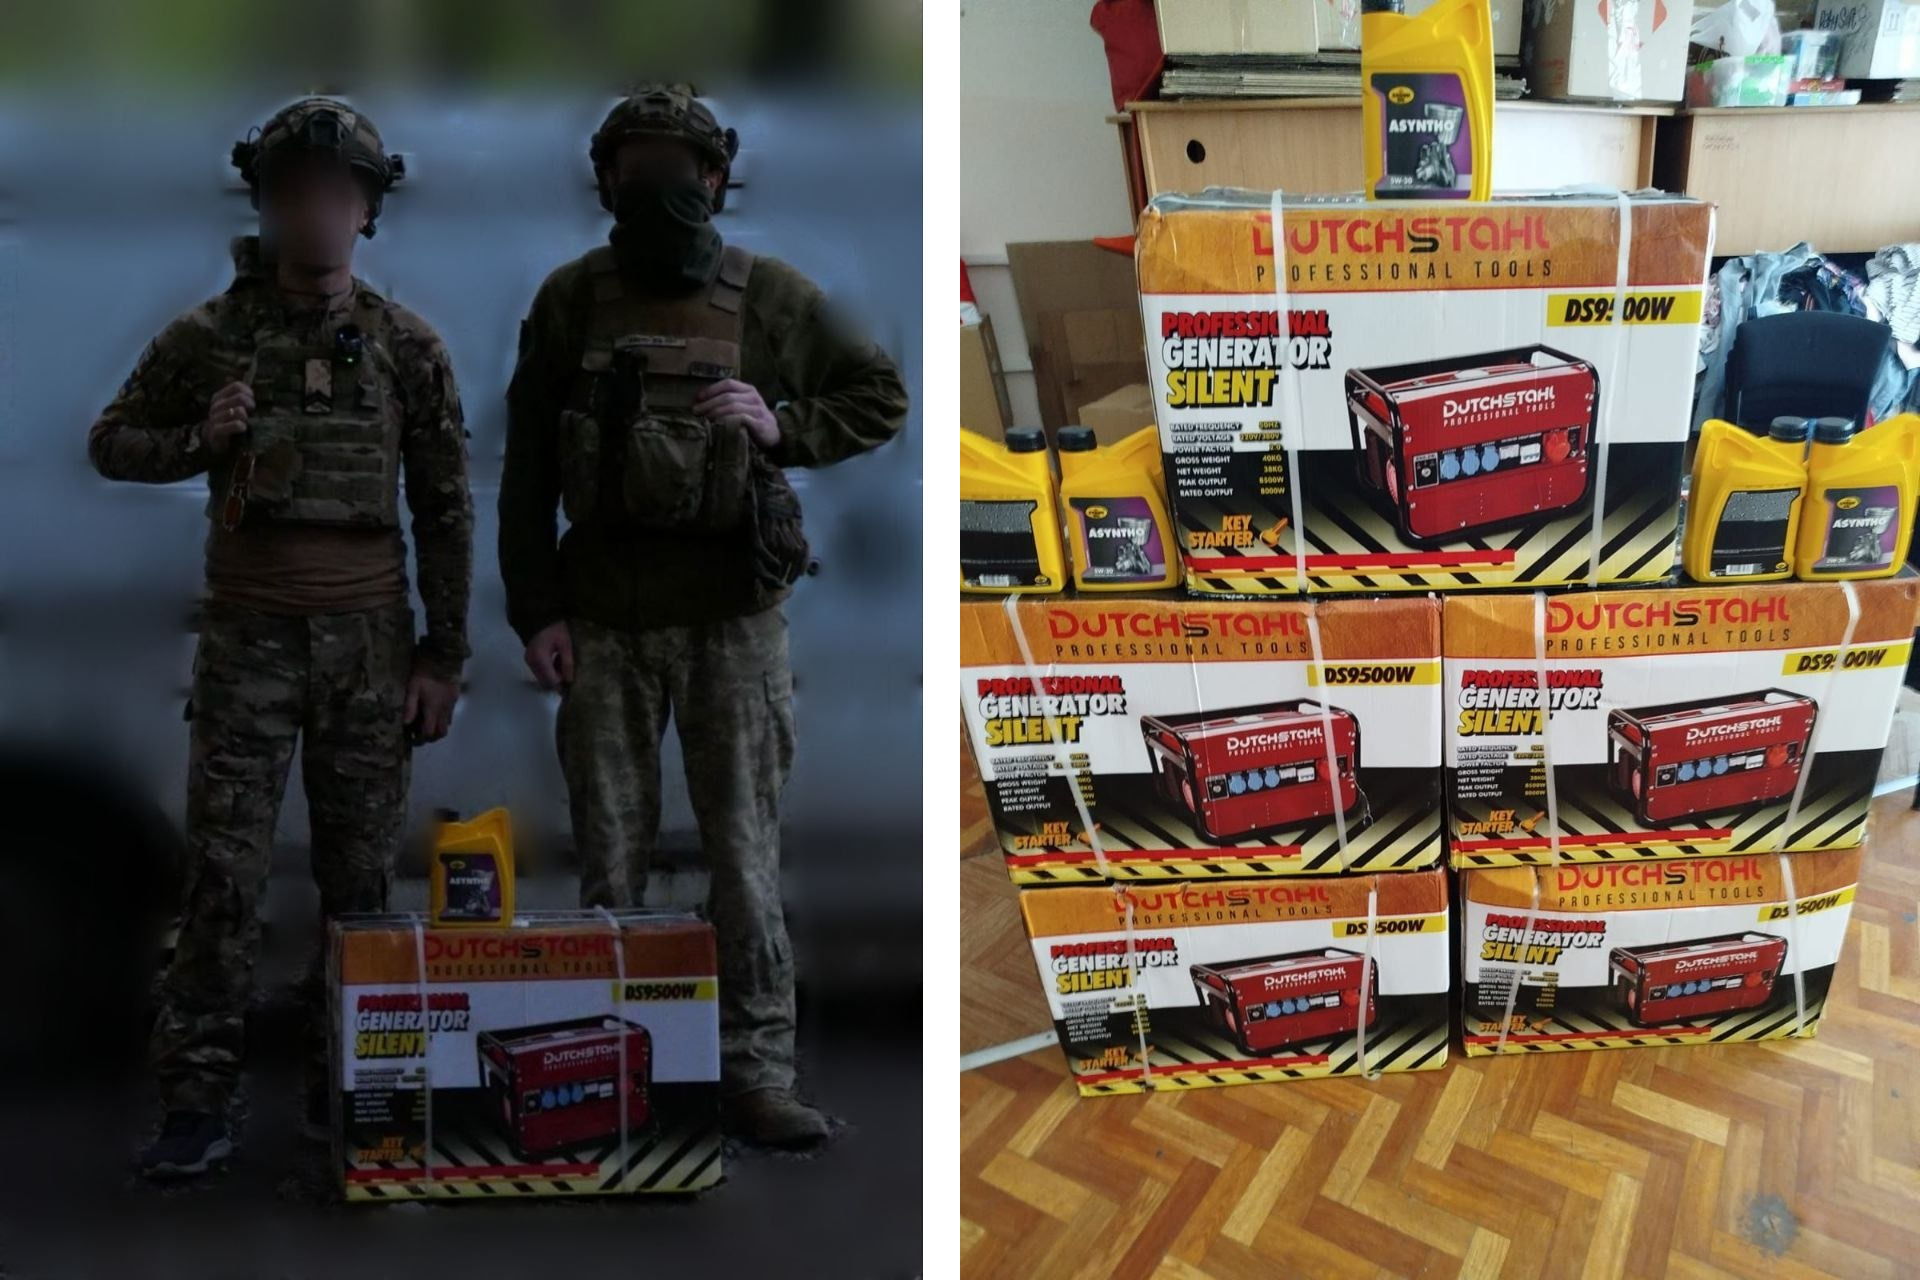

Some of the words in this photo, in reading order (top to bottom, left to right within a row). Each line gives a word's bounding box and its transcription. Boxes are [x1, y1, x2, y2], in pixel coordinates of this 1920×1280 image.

[1389, 119, 1454, 133] ASYNTHO
[1257, 262, 1452, 282] POFESSIONAL
[1474, 259, 1551, 278] TOOLS
[1167, 369, 1279, 408] SILENT
[1443, 408, 1520, 427] PROFESSIONAL
[1526, 402, 1556, 414] TOOLS
[1201, 456, 1230, 464] WEIGHT
[1192, 467, 1221, 475] WEIGHT
[1180, 489, 1203, 497] RATED
[1204, 488, 1234, 496] OUTPUT
[1222, 514, 1252, 531] KEY
[1832, 518, 1887, 528] ASYNTHO
[1089, 527, 1145, 539] ASYNTHO
[1188, 531, 1254, 549] STARTER
[1547, 633, 1708, 651] PROFESSIONAL
[1726, 628, 1790, 643] TOOLS
[1056, 642, 1223, 657] PROFESSIONAL
[1241, 642, 1309, 654] TOOLS
[1325, 666, 1416, 684] DS9500W
[977, 675, 1125, 696] PROFSSIONAL
[985, 717, 1083, 746] SILENT
[1490, 810, 1515, 822] KEY
[1044, 822, 1069, 834] KEY
[1460, 821, 1515, 835] STARTER
[1014, 834, 1072, 849] STARTER
[1559, 890, 1695, 907] PROFESSIONAL
[1709, 886, 1764, 899] TOOLS
[1769, 893, 1841, 920] DS500W
[1119, 909, 1261, 926] PROFESSIONAL
[1276, 904, 1334, 917] TOOLS
[1346, 919, 1425, 935] DS500W
[426, 963, 549, 976] ROFESSIONAL
[625, 984, 698, 1000] DS9500W
[1481, 1022, 1527, 1032] STAER
[544, 1044, 620, 1065] DUTCHSTAH
